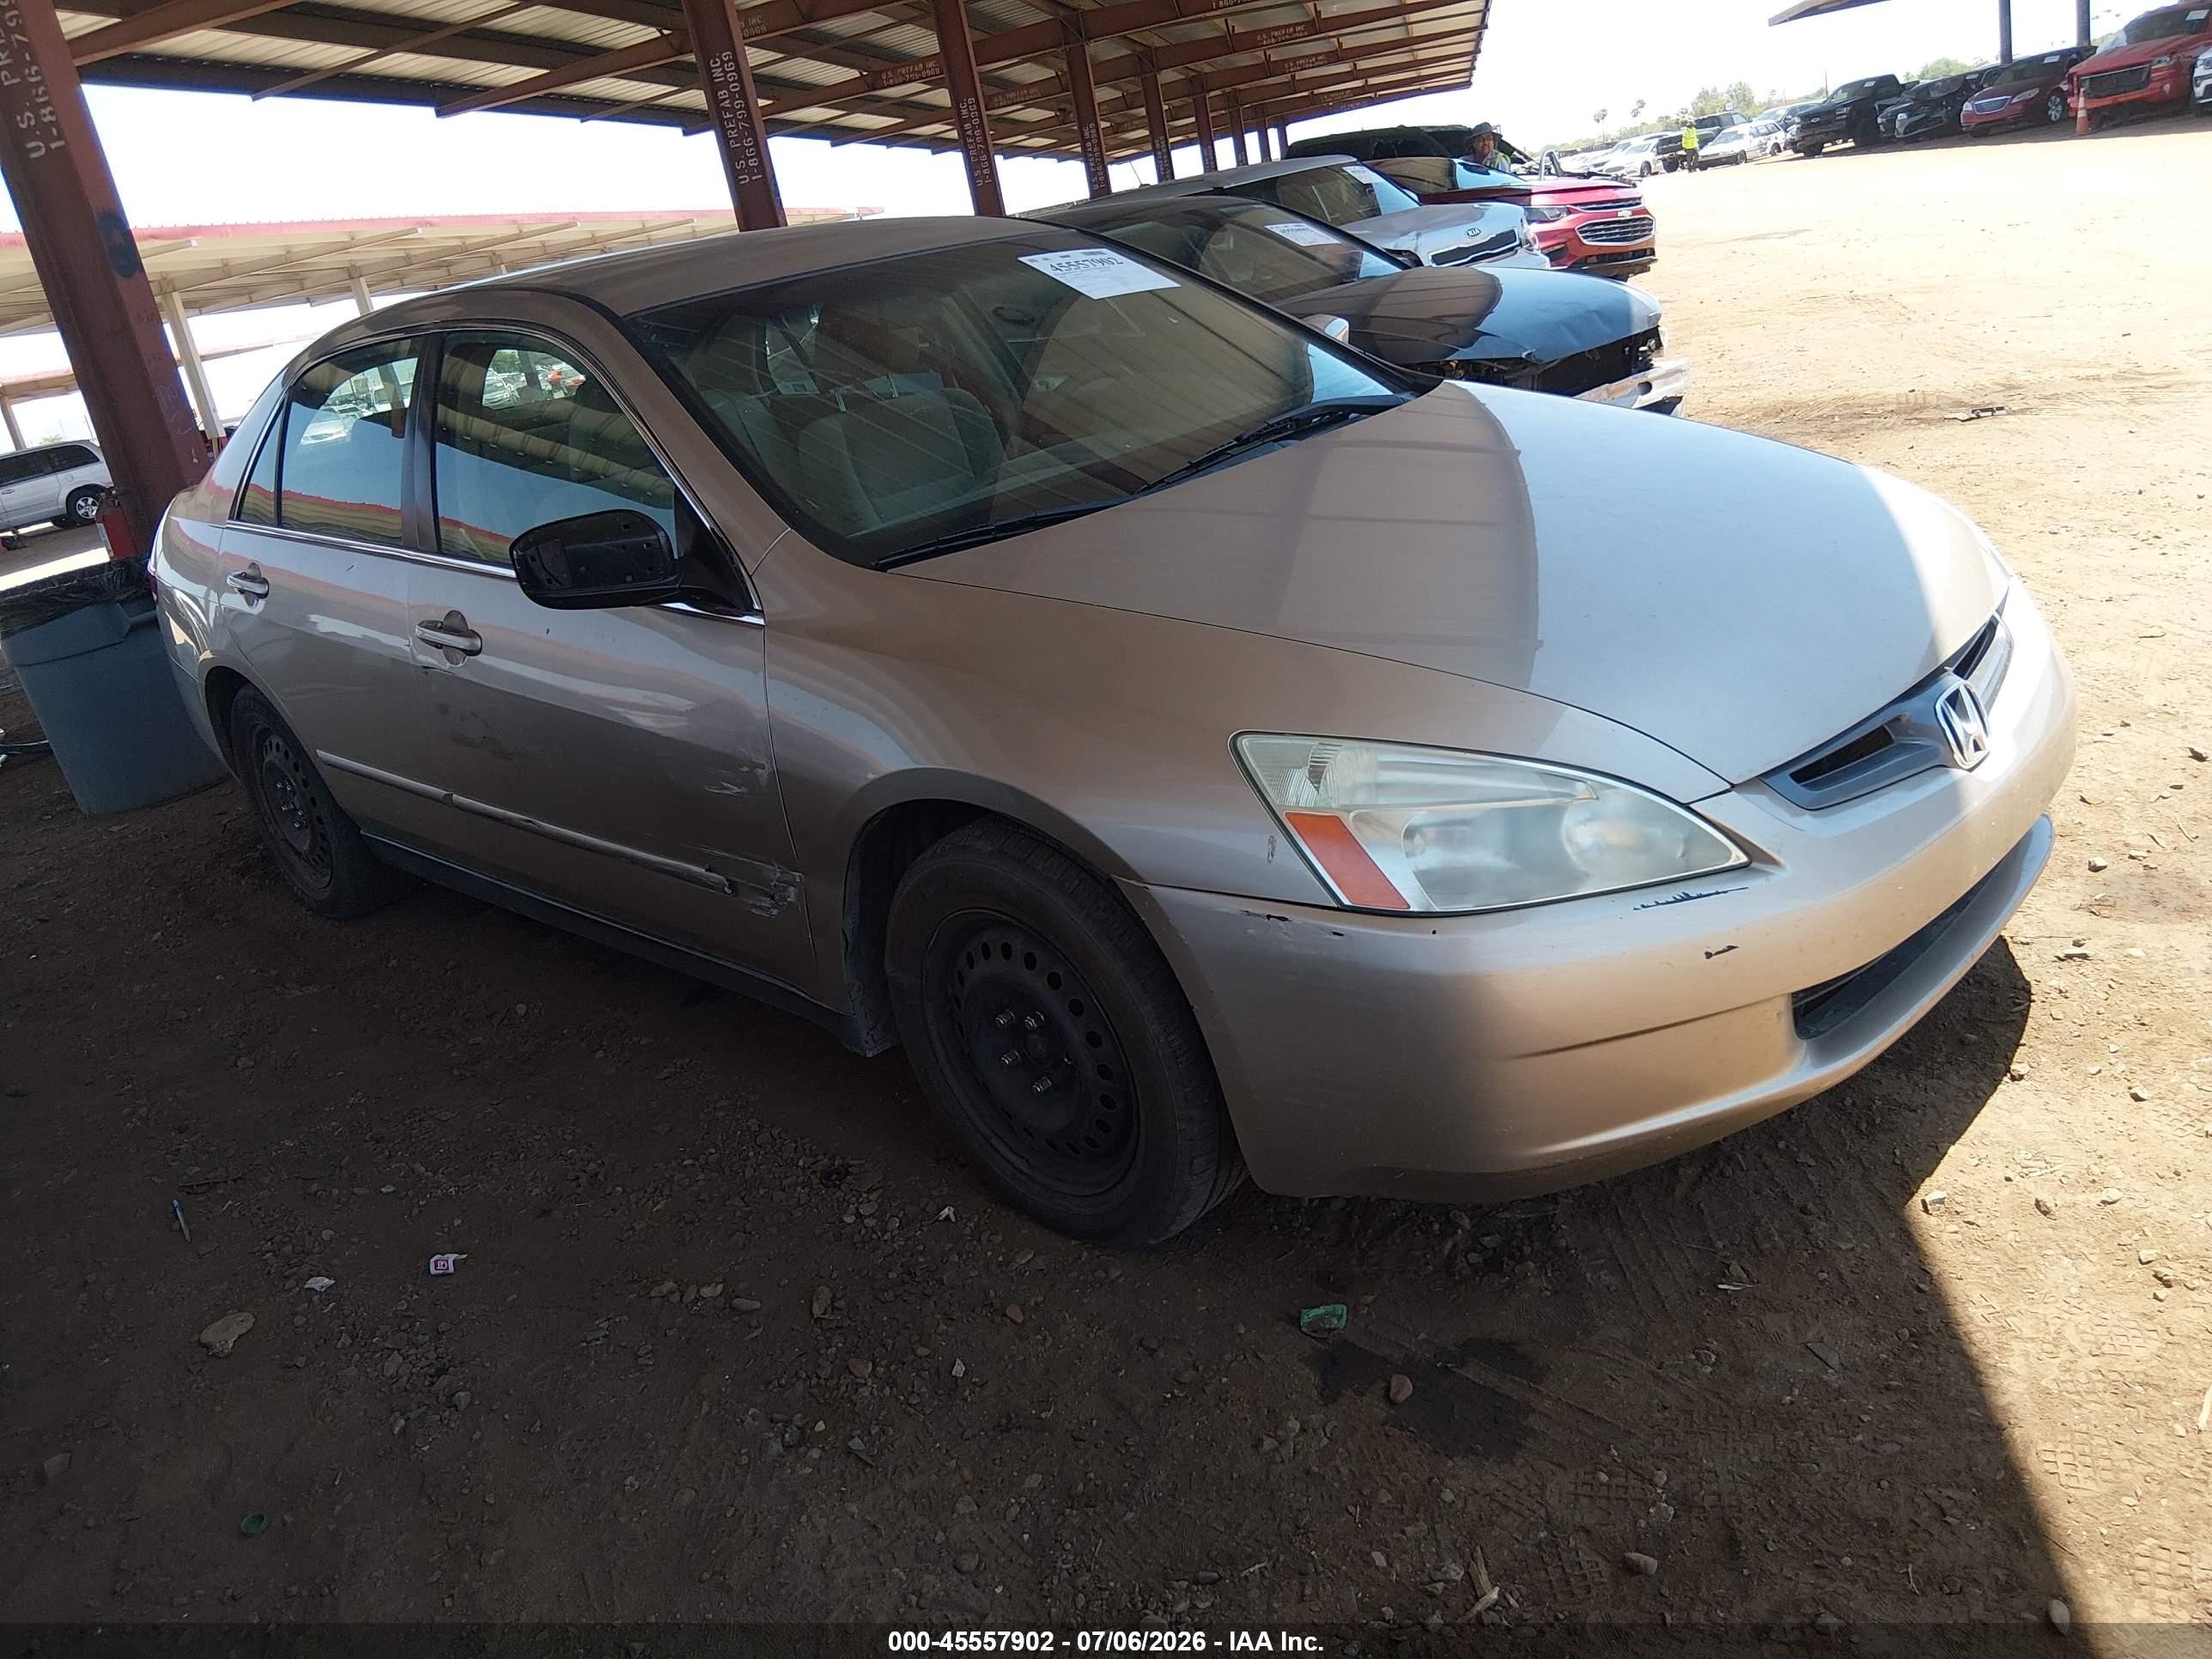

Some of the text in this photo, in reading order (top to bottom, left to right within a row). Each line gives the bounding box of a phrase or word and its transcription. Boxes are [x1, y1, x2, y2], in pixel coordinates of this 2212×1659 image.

[16, 102, 46, 158] U.S.
[709, 52, 750, 185] U.S. PREFAB INC.
[721, 51, 763, 180] 1-866-799-0969
